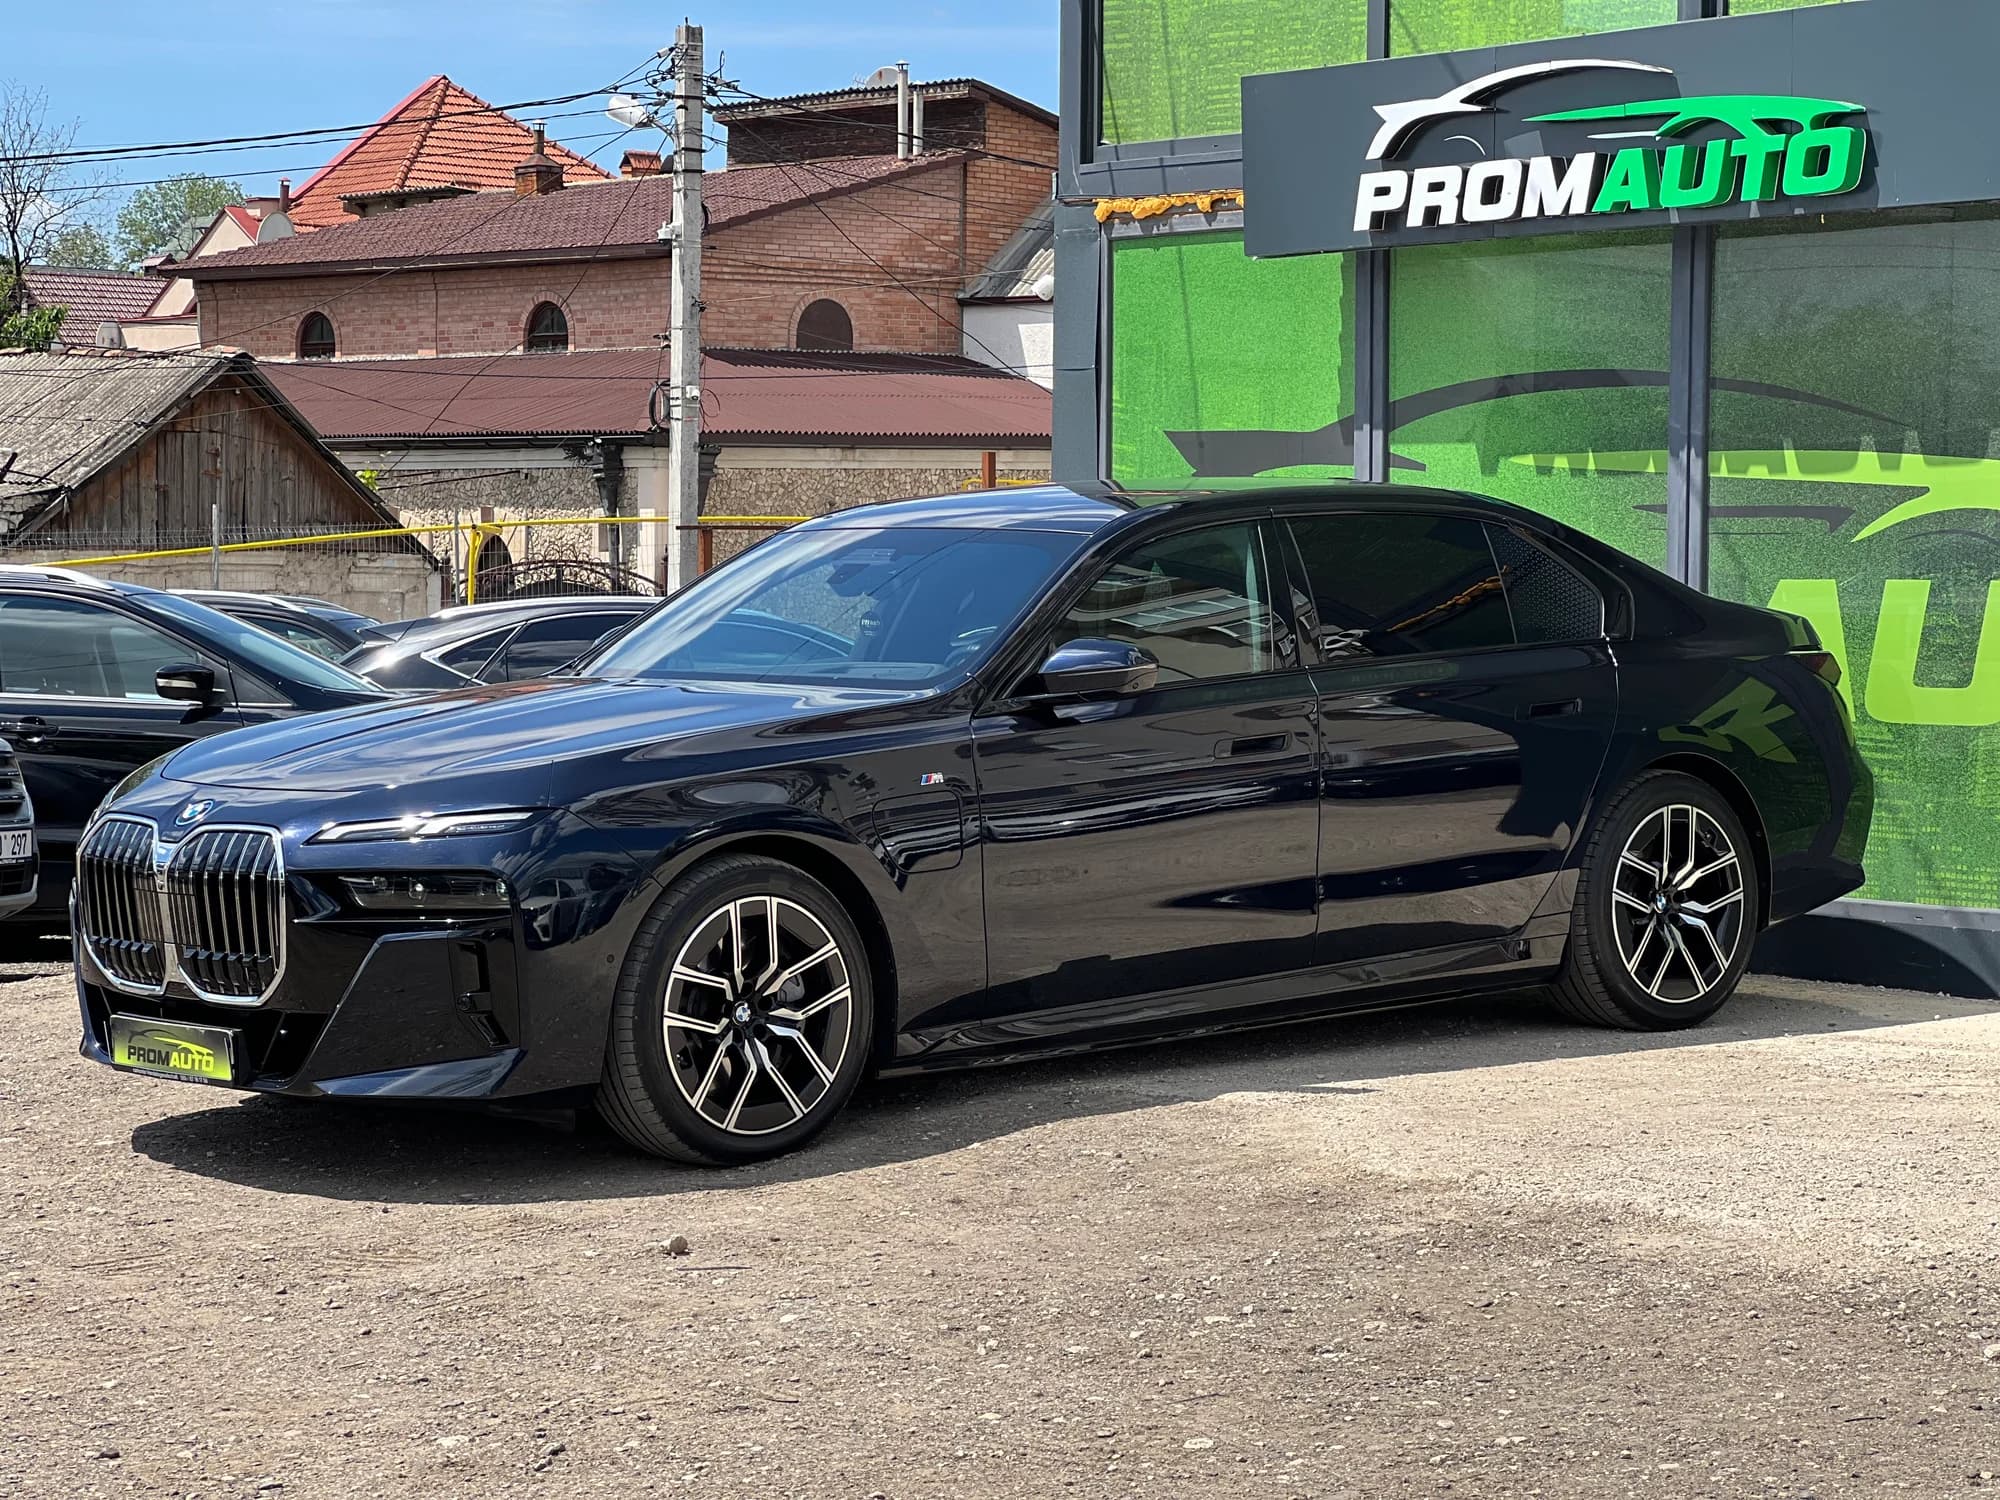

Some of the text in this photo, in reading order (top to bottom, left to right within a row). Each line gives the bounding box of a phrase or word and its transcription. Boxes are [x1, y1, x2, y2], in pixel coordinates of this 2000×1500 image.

[1353, 127, 1867, 232] PROMAUTO
[10, 833, 27, 856] 297
[127, 1045, 215, 1073] PROMAUTO
